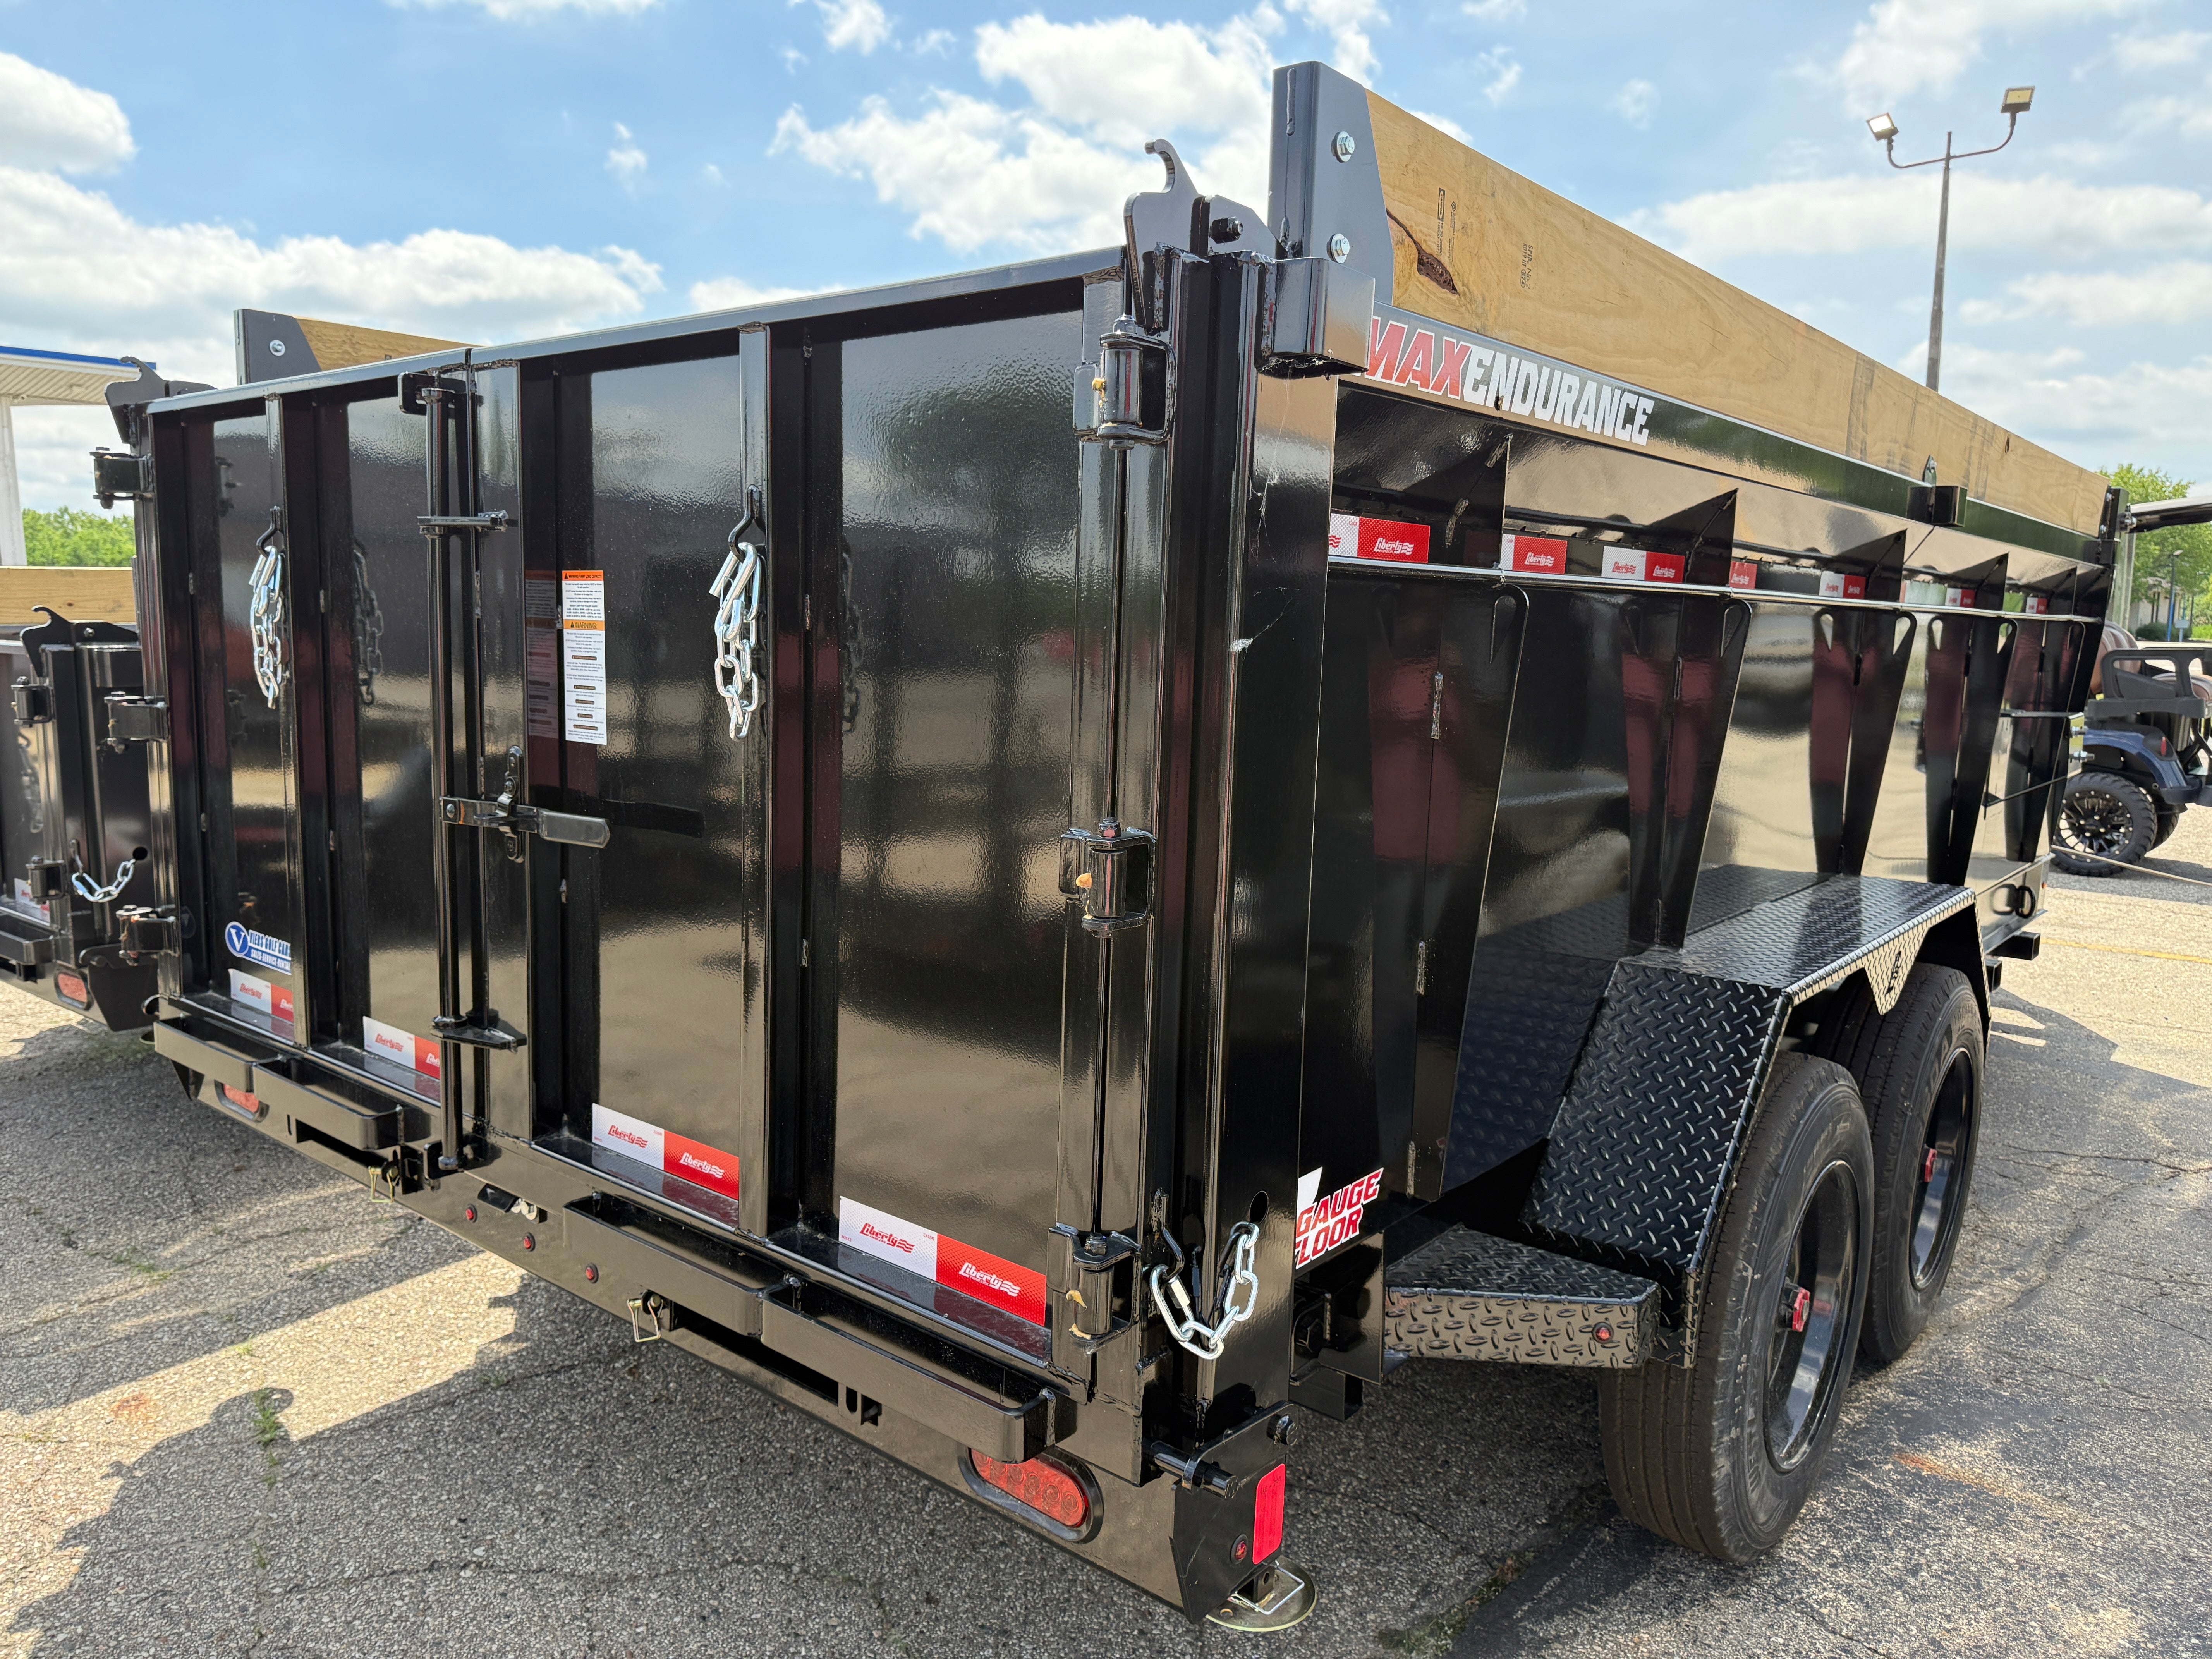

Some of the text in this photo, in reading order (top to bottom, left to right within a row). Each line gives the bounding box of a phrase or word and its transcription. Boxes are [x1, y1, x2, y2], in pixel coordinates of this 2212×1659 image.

[1374, 537, 1403, 554] Liberty
[265, 937, 277, 953] GOLF
[608, 1125, 636, 1144] Liberty
[680, 1152, 712, 1174] Liberty
[1296, 1167, 1384, 1238] GAUGE
[859, 1223, 898, 1247] Liberty
[958, 1262, 1003, 1290] Liberty
